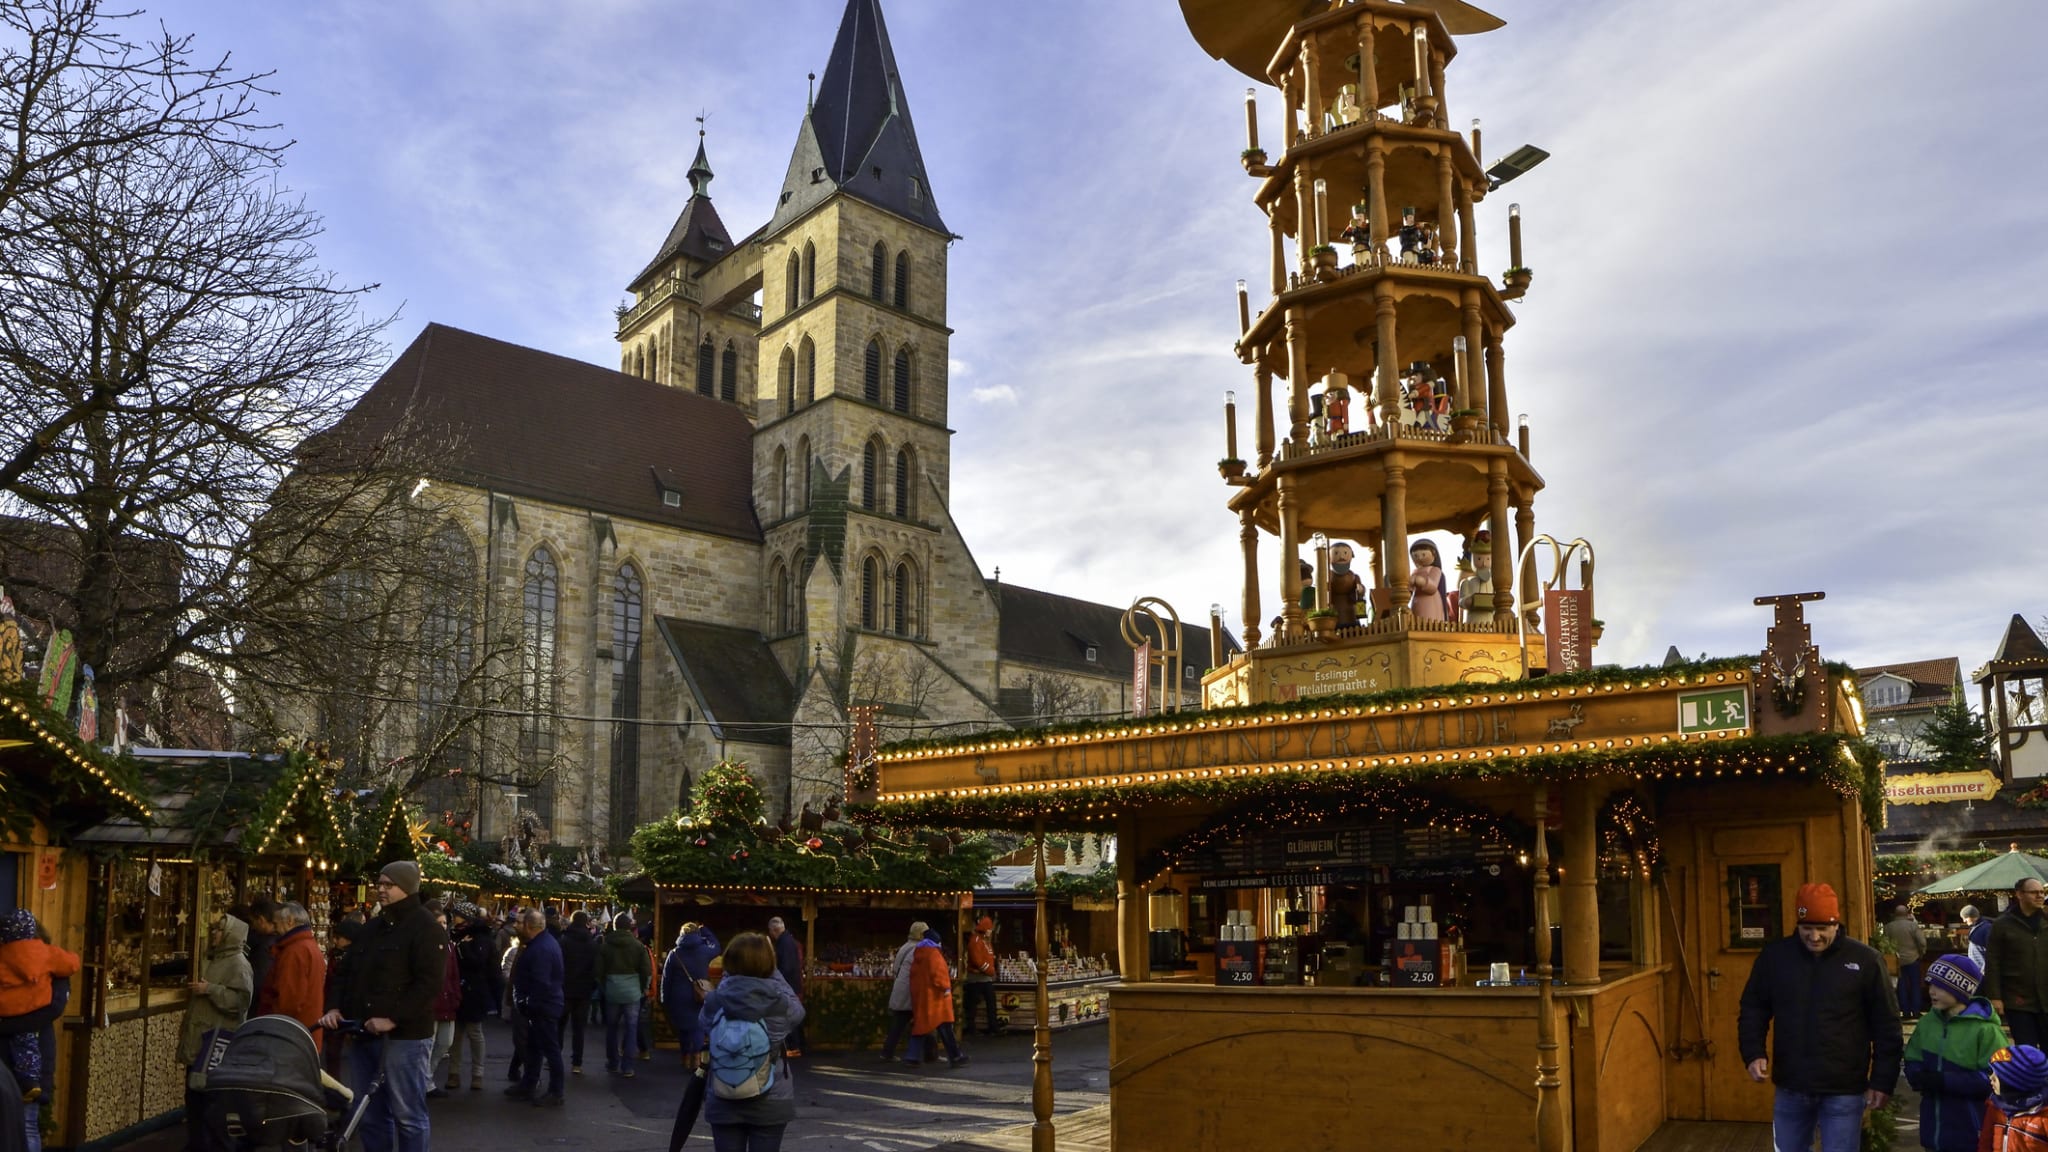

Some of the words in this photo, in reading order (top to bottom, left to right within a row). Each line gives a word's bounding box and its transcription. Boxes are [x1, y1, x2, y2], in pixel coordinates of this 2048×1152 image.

[1559, 596, 1572, 663] GLÜHWEIN
[1570, 596, 1579, 657] PYRAMIDE
[1315, 669, 1358, 681] Esslinger
[1279, 679, 1367, 701] Mittelaltermarkt
[1369, 679, 1378, 689] &
[1287, 839, 1334, 854] GLÜHWEIN
